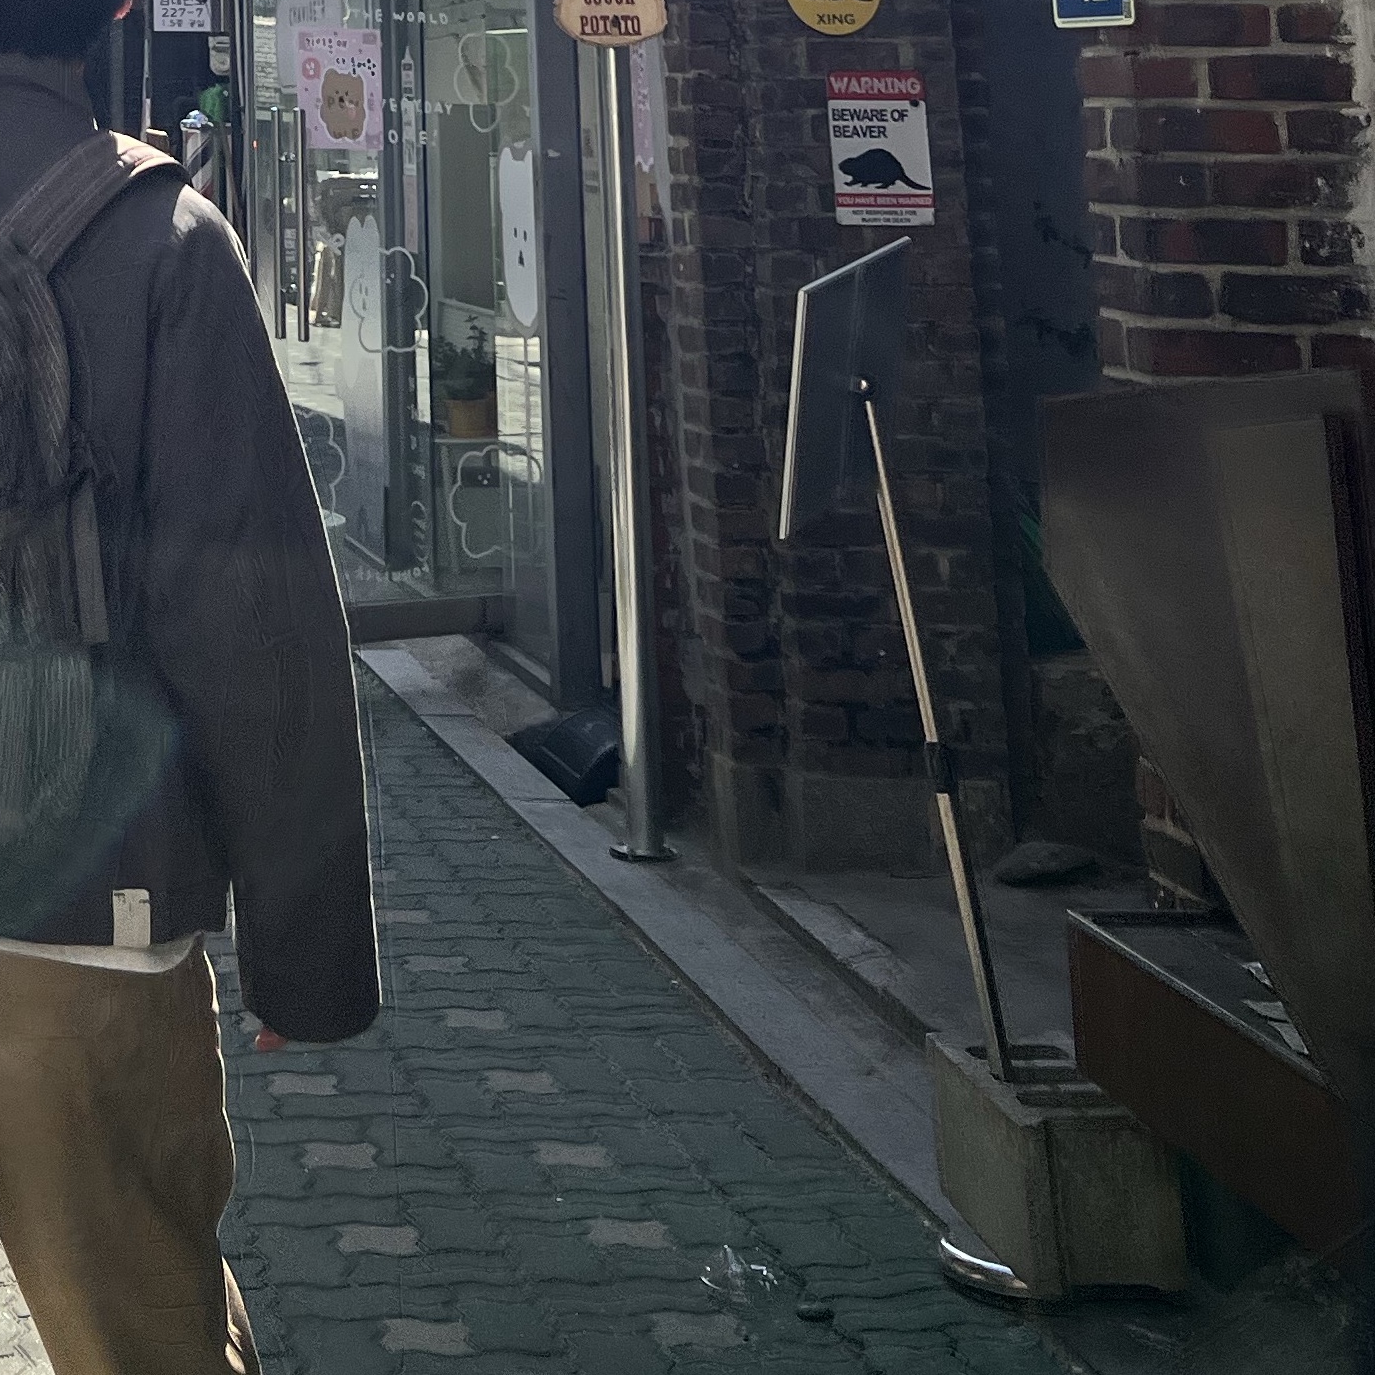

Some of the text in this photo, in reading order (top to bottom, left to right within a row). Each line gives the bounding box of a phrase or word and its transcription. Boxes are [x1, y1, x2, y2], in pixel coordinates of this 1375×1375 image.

[392, 10, 450, 26] WORLD
[816, 13, 857, 26] XING
[829, 76, 922, 95] WARNING
[831, 107, 909, 123] BEWARE OF
[832, 125, 889, 139] BEAVER
